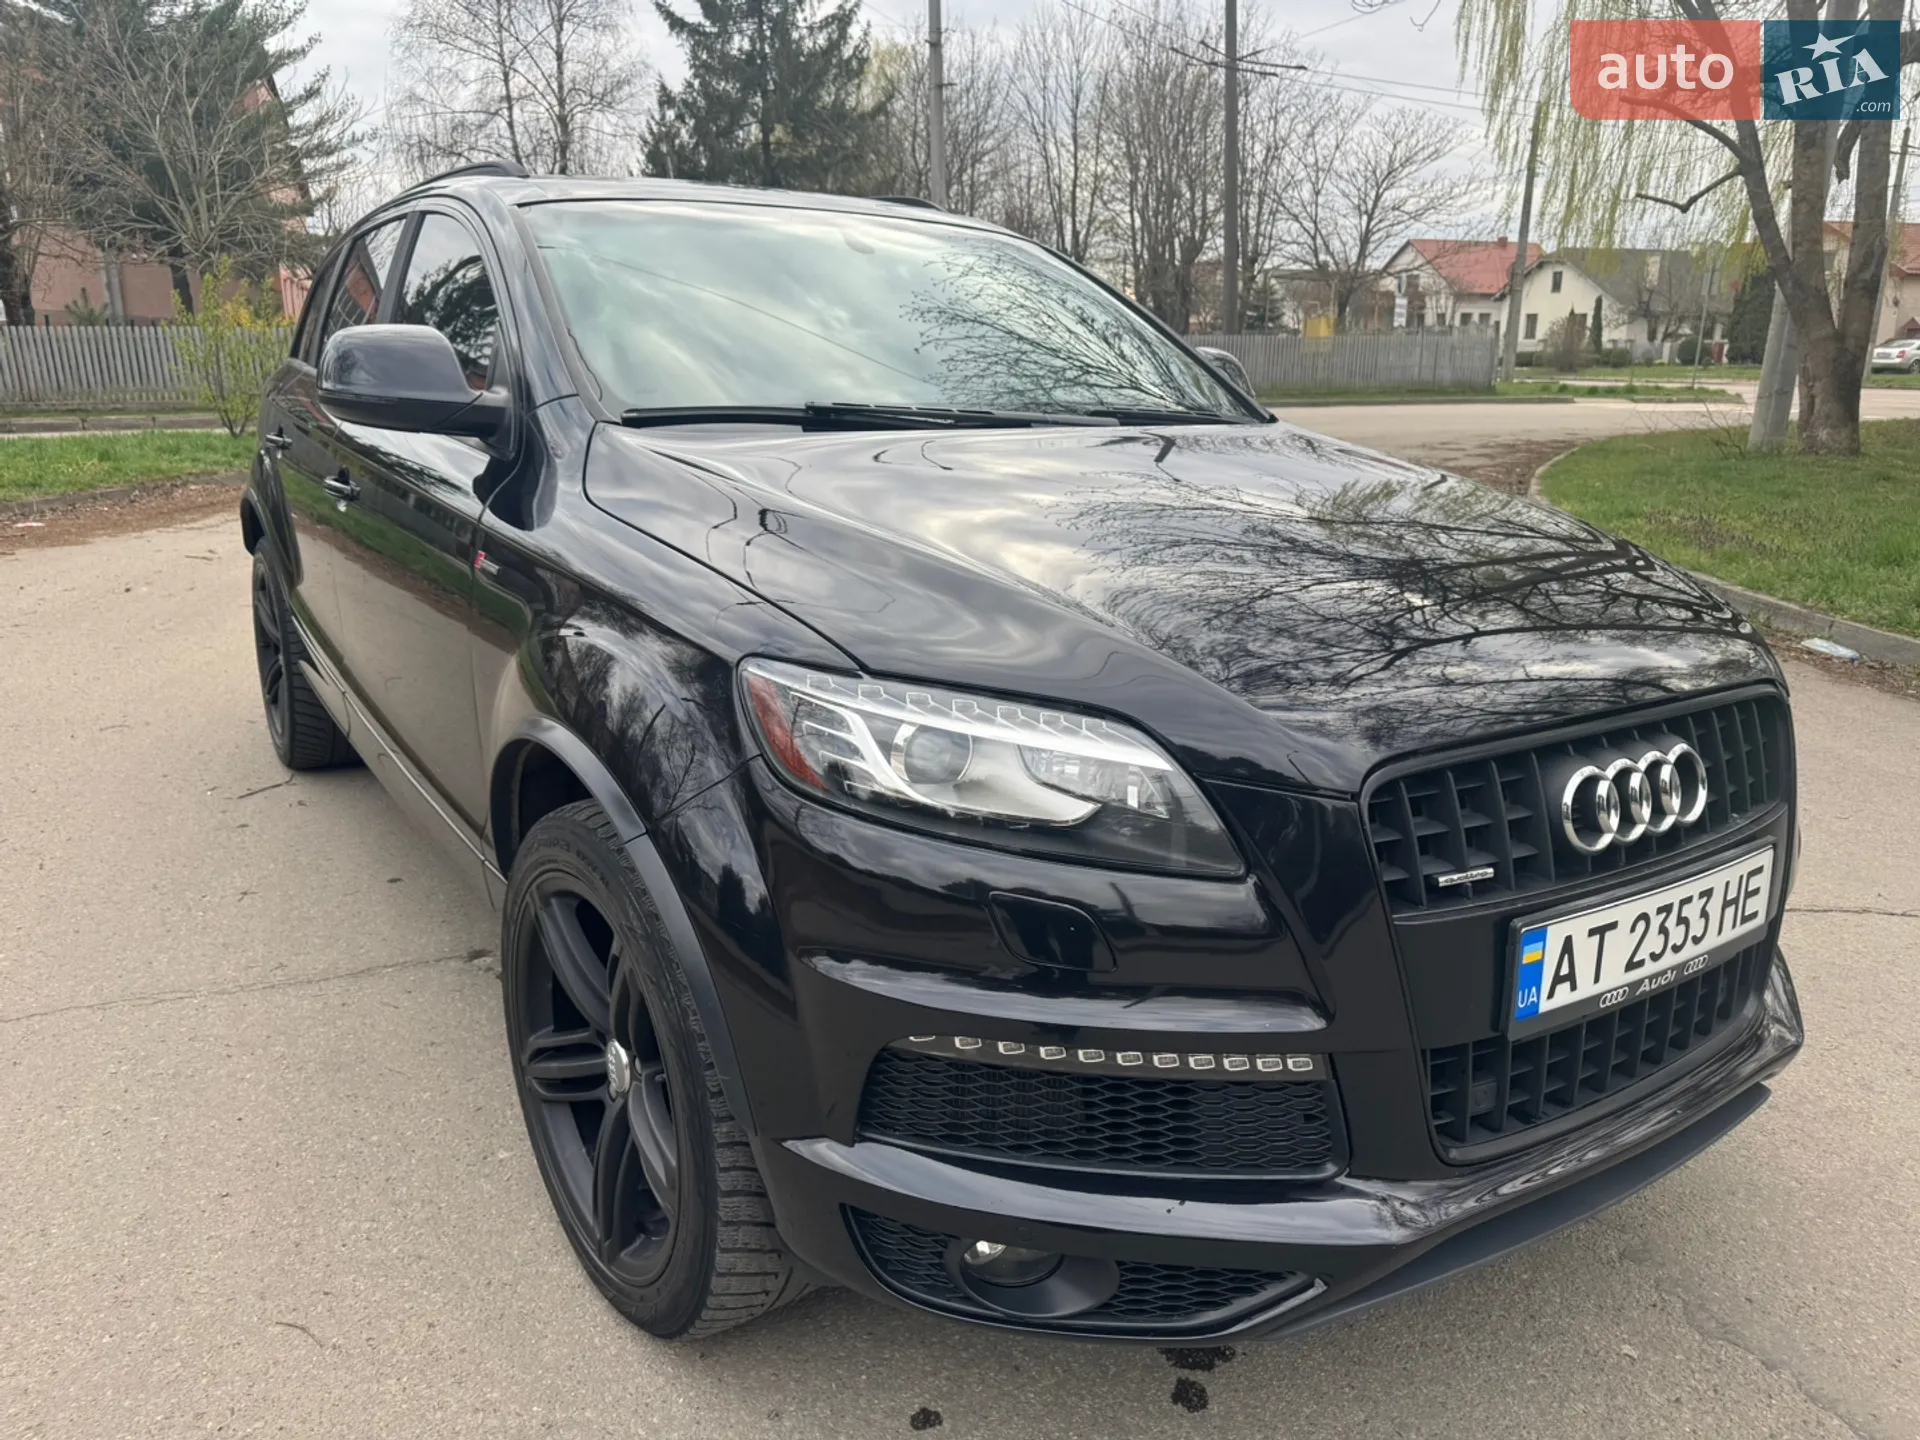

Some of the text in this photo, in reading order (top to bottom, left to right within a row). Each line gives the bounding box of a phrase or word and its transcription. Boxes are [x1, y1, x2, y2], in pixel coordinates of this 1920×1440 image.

[1545, 864, 1765, 1001] AT 2353 HE
[1636, 970, 1677, 996] Audi
[1518, 987, 1538, 1008] UA
